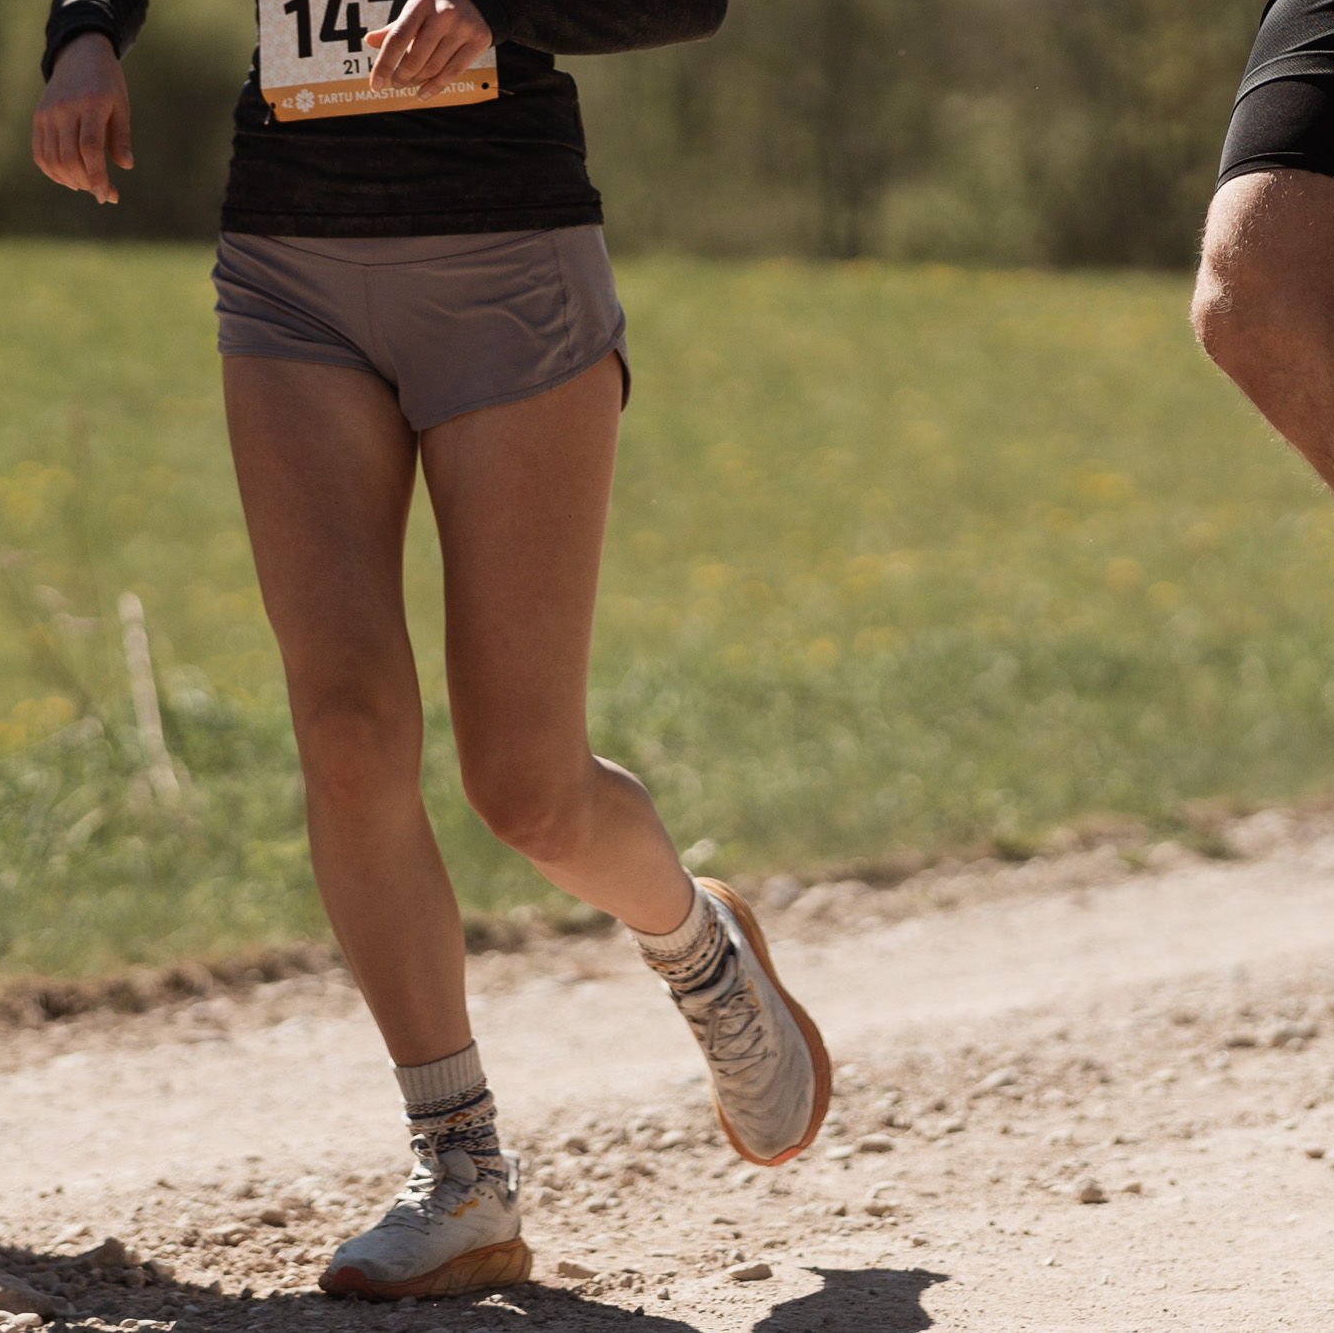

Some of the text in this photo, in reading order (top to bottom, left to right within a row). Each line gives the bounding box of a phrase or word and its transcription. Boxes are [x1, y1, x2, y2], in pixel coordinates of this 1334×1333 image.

[342, 59, 360, 75] 21
[281, 97, 295, 109] 42
[317, 90, 354, 105] TARTU
